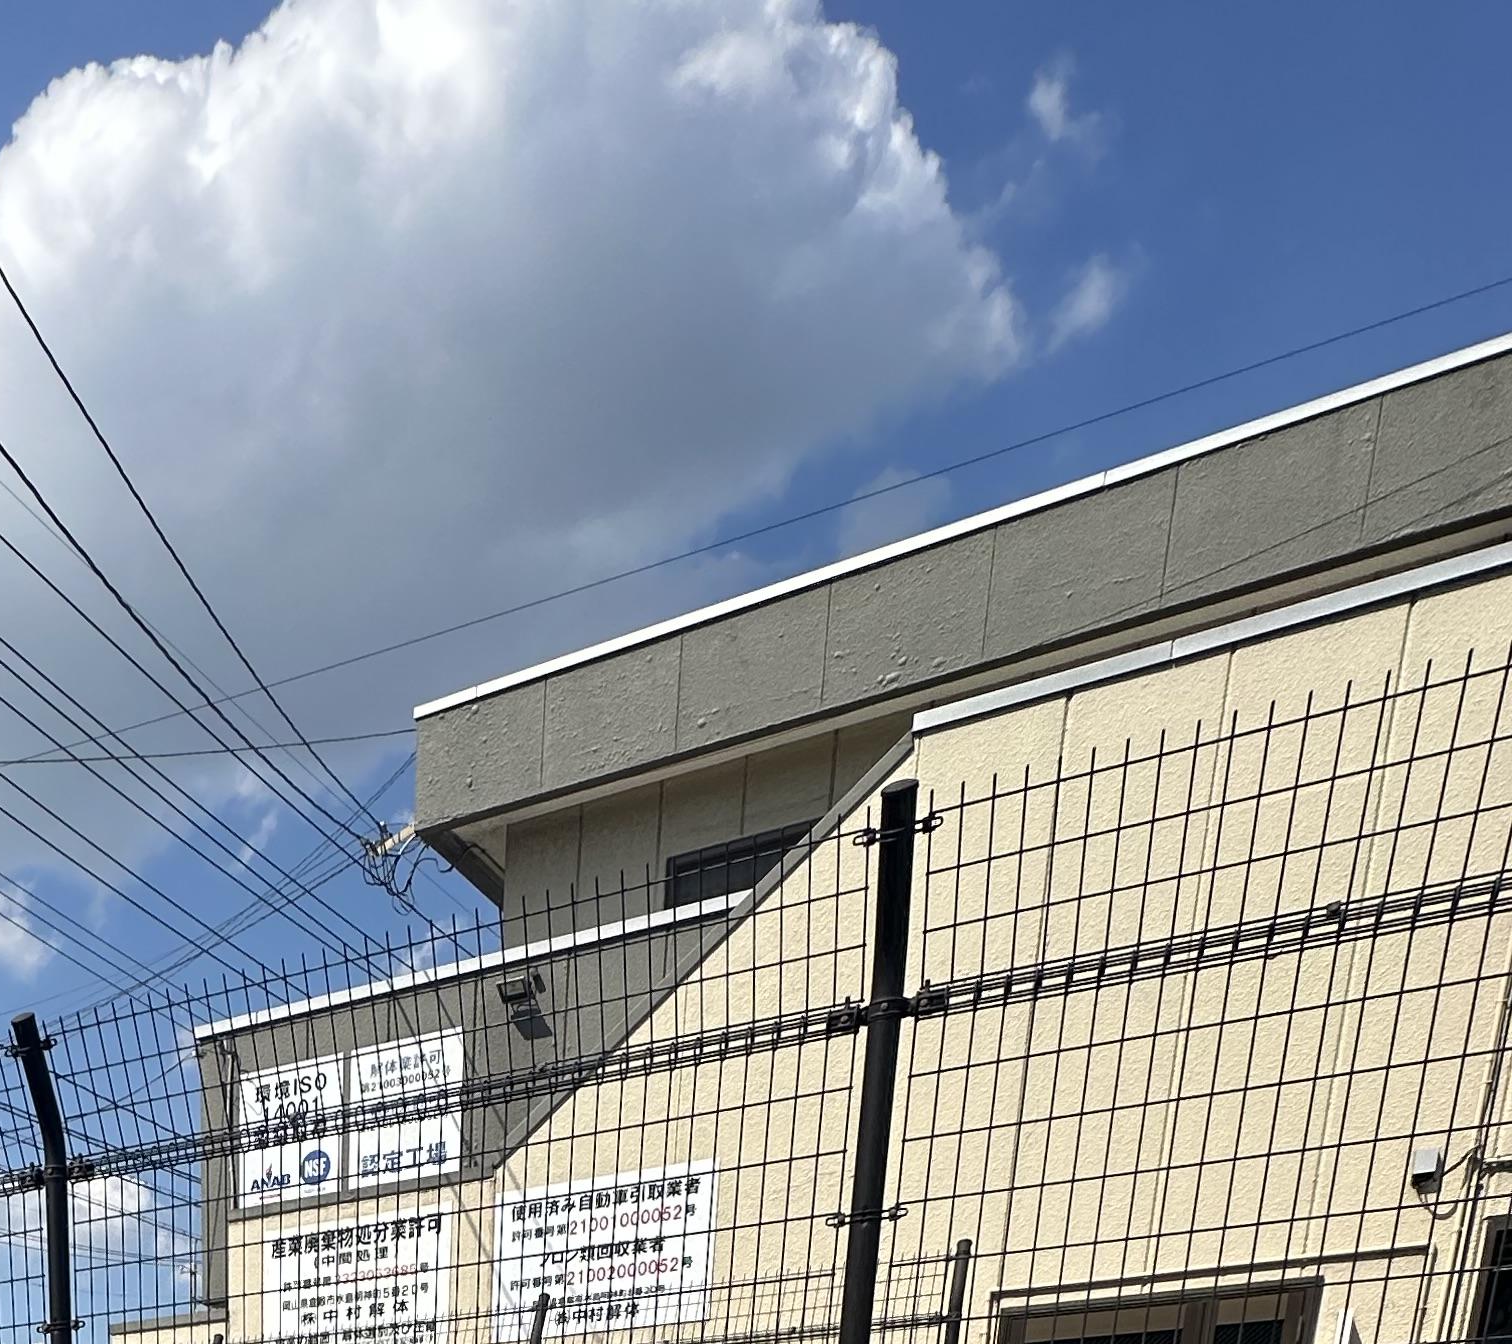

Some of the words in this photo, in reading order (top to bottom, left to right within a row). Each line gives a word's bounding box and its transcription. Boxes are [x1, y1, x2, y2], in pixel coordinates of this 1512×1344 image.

[254, 1072, 327, 1103] 環境ISO
[304, 1156, 328, 1176] NSF
[361, 1141, 448, 1178] 認定工場
[512, 1177, 701, 1222] 使用済み自動車引取業者
[272, 1212, 442, 1259] 産業廃棄物処分業許可
